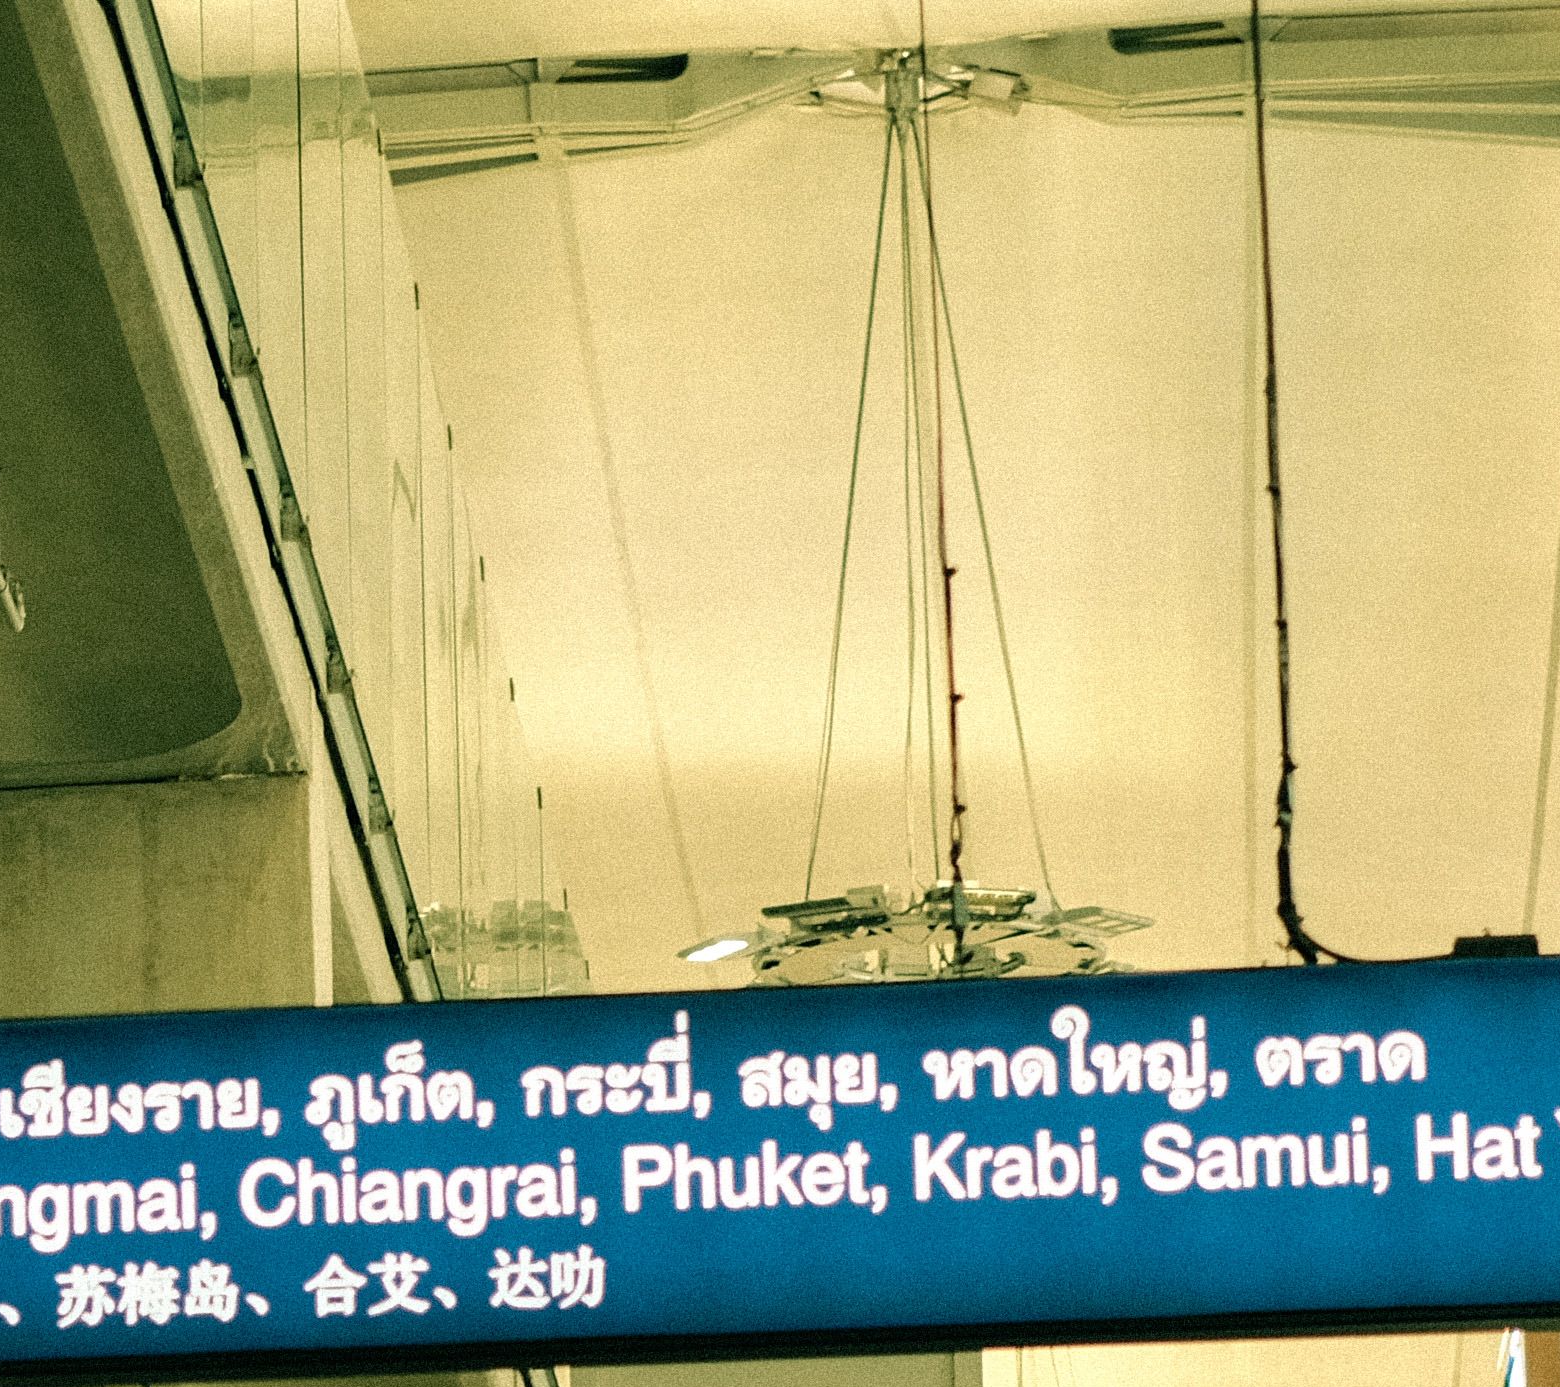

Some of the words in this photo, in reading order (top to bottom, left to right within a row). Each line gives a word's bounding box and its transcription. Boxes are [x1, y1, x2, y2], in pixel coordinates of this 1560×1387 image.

[304, 1039, 495, 1151] ภูเก็ต,
[520, 1010, 712, 1120] กระบี่,
[737, 1050, 899, 1131] สมุย,
[922, 1005, 1229, 1111] หาดใหญ่,
[1254, 1030, 1427, 1088] ตราด
[238, 1147, 598, 1238] Chiangrai,
[621, 1138, 888, 1214] Phuket,
[912, 1126, 1119, 1206] Krabi,
[1141, 1116, 1390, 1195] Samui,
[1415, 1112, 1543, 1182] Hat
